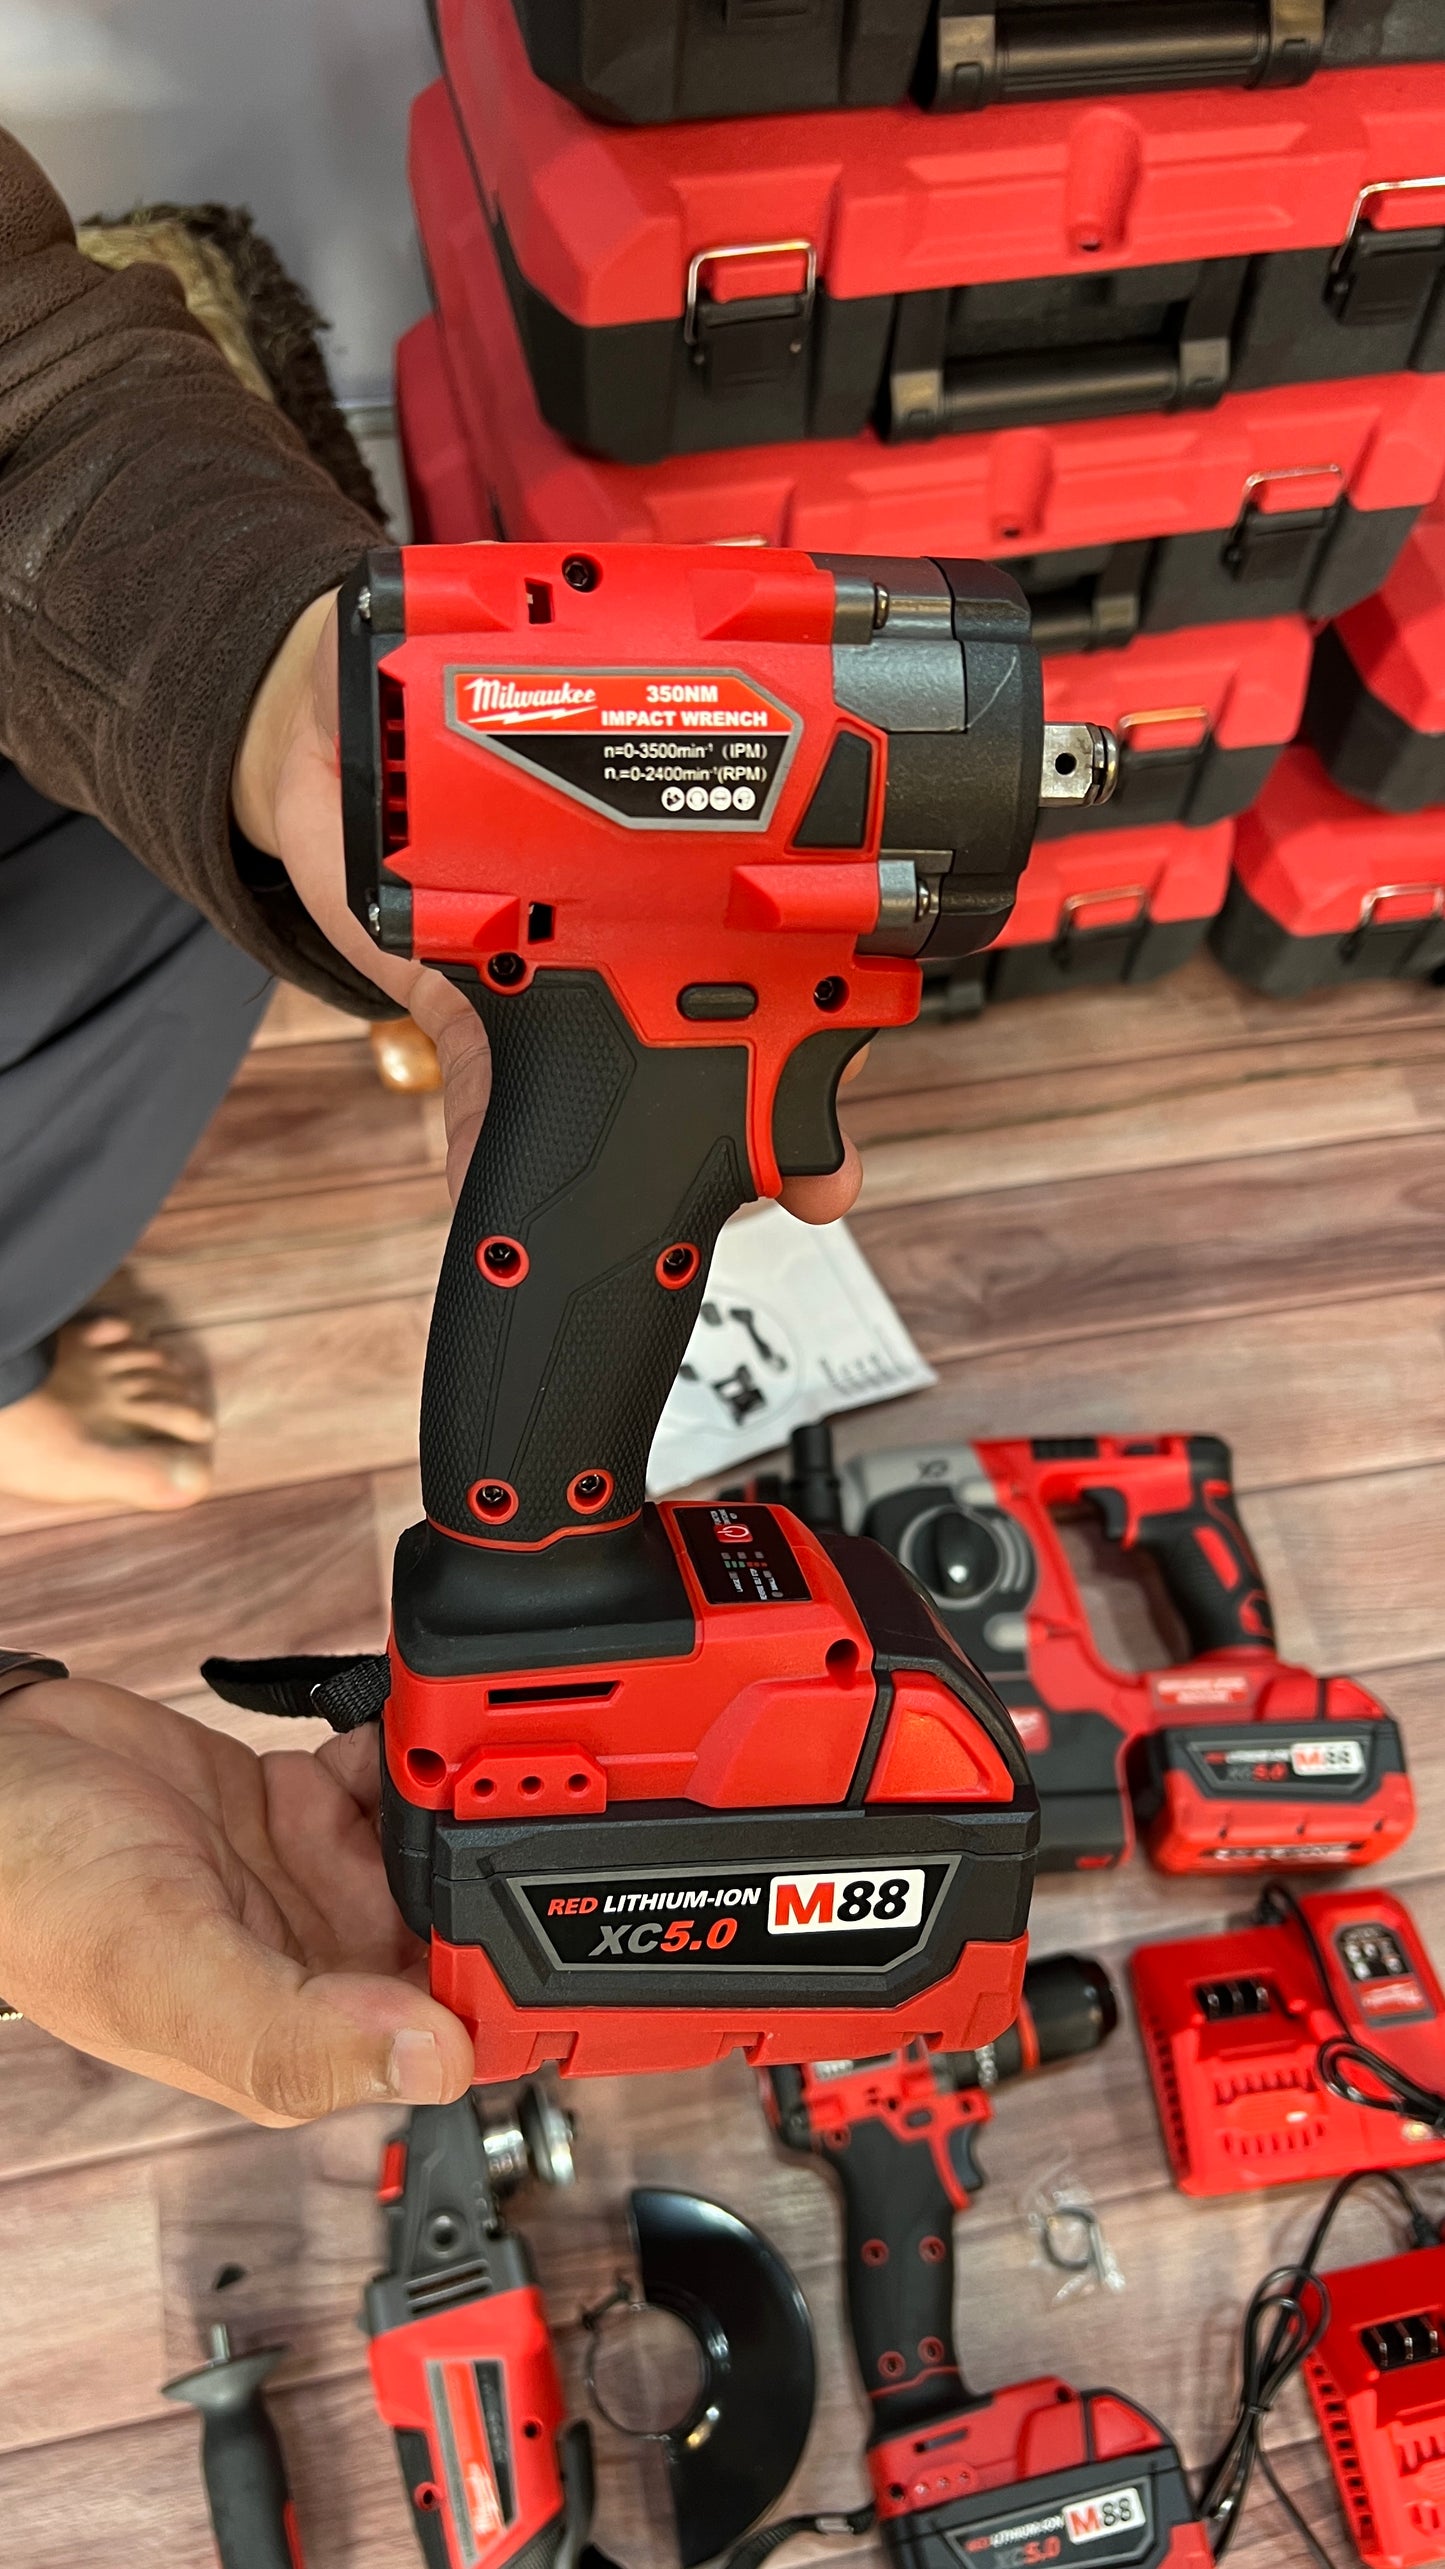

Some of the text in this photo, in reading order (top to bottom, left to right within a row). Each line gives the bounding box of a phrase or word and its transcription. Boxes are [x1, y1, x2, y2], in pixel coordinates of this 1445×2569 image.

[463, 678, 597, 712] Milwaukee
[646, 685, 718, 703] 350NM
[601, 711, 768, 728] IMPACT WRENCH
[547, 1887, 762, 1917] RED LITHIUM-ION
[774, 1878, 910, 1926] M88
[588, 1917, 738, 1957] XC5.0
[1069, 2497, 1133, 2537] M88
